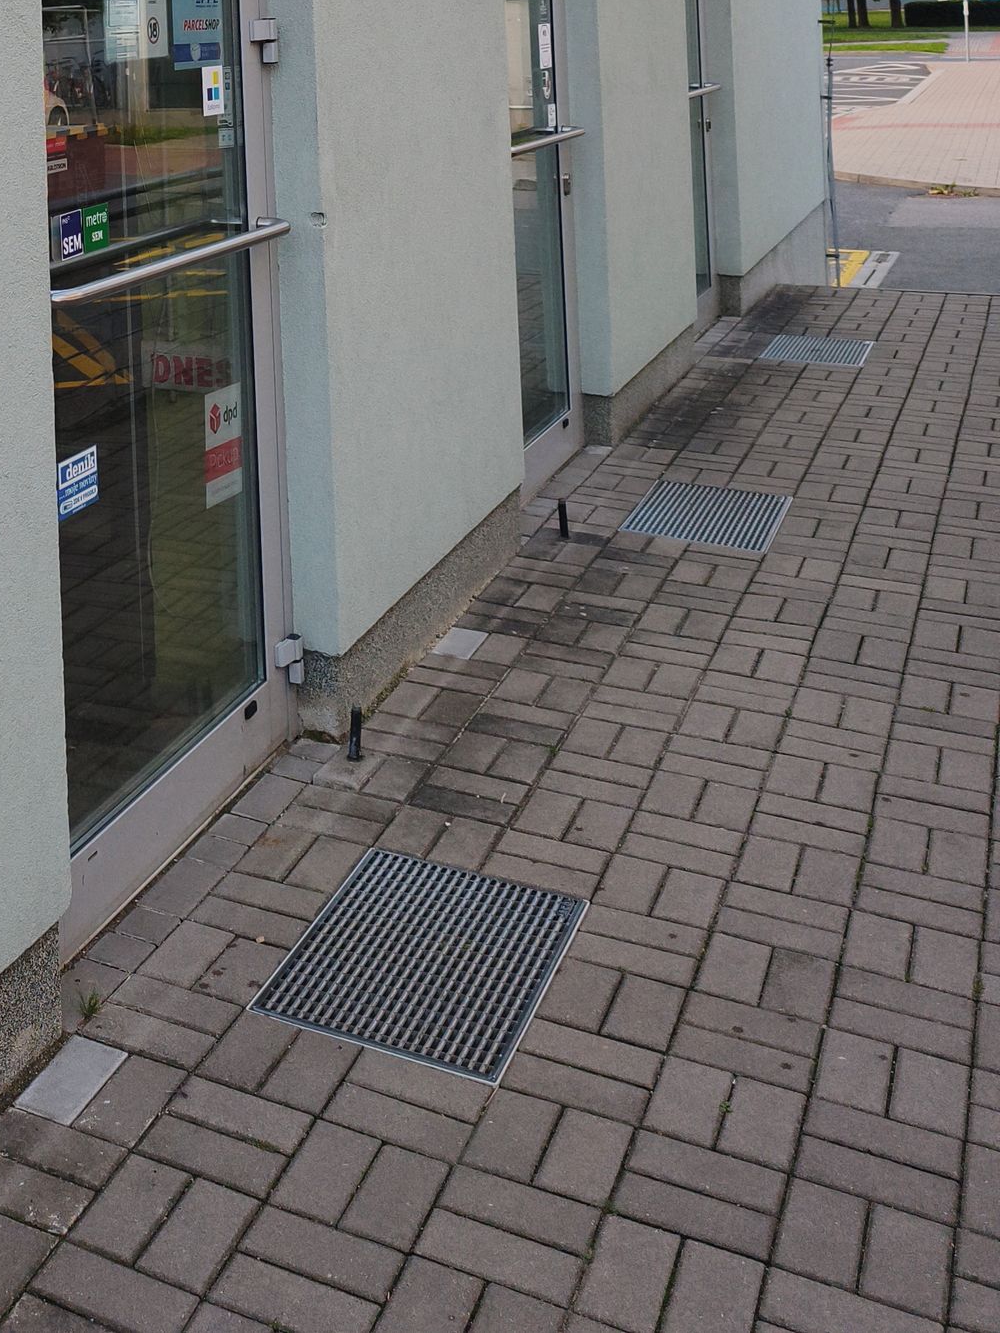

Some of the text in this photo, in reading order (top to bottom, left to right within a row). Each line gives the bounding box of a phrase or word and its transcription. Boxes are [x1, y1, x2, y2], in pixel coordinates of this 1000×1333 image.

[183, 18, 220, 31] PARCELSHOP
[86, 211, 108, 228] metro
[63, 233, 82, 255] SEM
[91, 230, 104, 242] SEM
[223, 402, 238, 426] dpd
